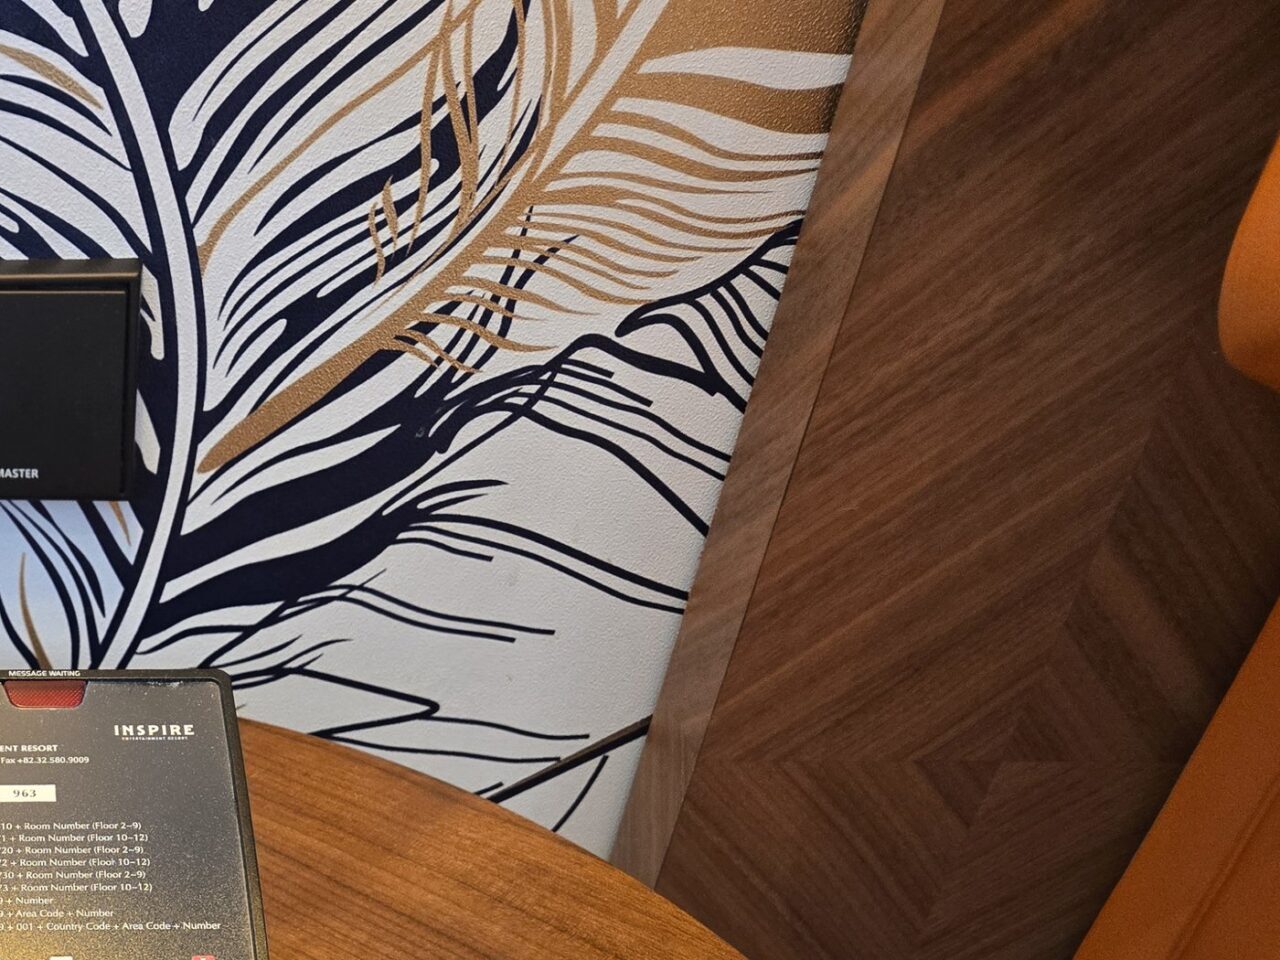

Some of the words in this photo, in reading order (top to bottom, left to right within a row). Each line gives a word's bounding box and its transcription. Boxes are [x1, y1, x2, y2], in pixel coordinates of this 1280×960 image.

[114, 724, 195, 736] INSPIRE
[21, 744, 58, 752] RESORT
[13, 789, 37, 798] 963
[24, 822, 51, 830] Room
[53, 822, 90, 830] Number
[92, 822, 118, 830] (Floor
[19, 834, 46, 842] Room
[48, 834, 85, 842] Number
[87, 834, 113, 842] (Floor
[25, 846, 52, 854] Room
[54, 846, 91, 854] Number
[93, 846, 120, 854] (Floor
[88, 858, 115, 867] (Floor
[26, 871, 53, 879] Room
[55, 871, 93, 879] Number
[95, 871, 122, 879] (Floor
[21, 884, 48, 892] Room
[50, 884, 88, 892] Number
[90, 883, 117, 892] (Floor
[15, 910, 37, 918] Area
[39, 909, 64, 918] Code
[76, 909, 114, 917] Number
[16, 923, 33, 931] 001
[46, 922, 83, 932] Country
[86, 922, 111, 930] Code
[122, 922, 144, 930] Area
[145, 921, 171, 930] Code
[182, 921, 221, 930] Number
